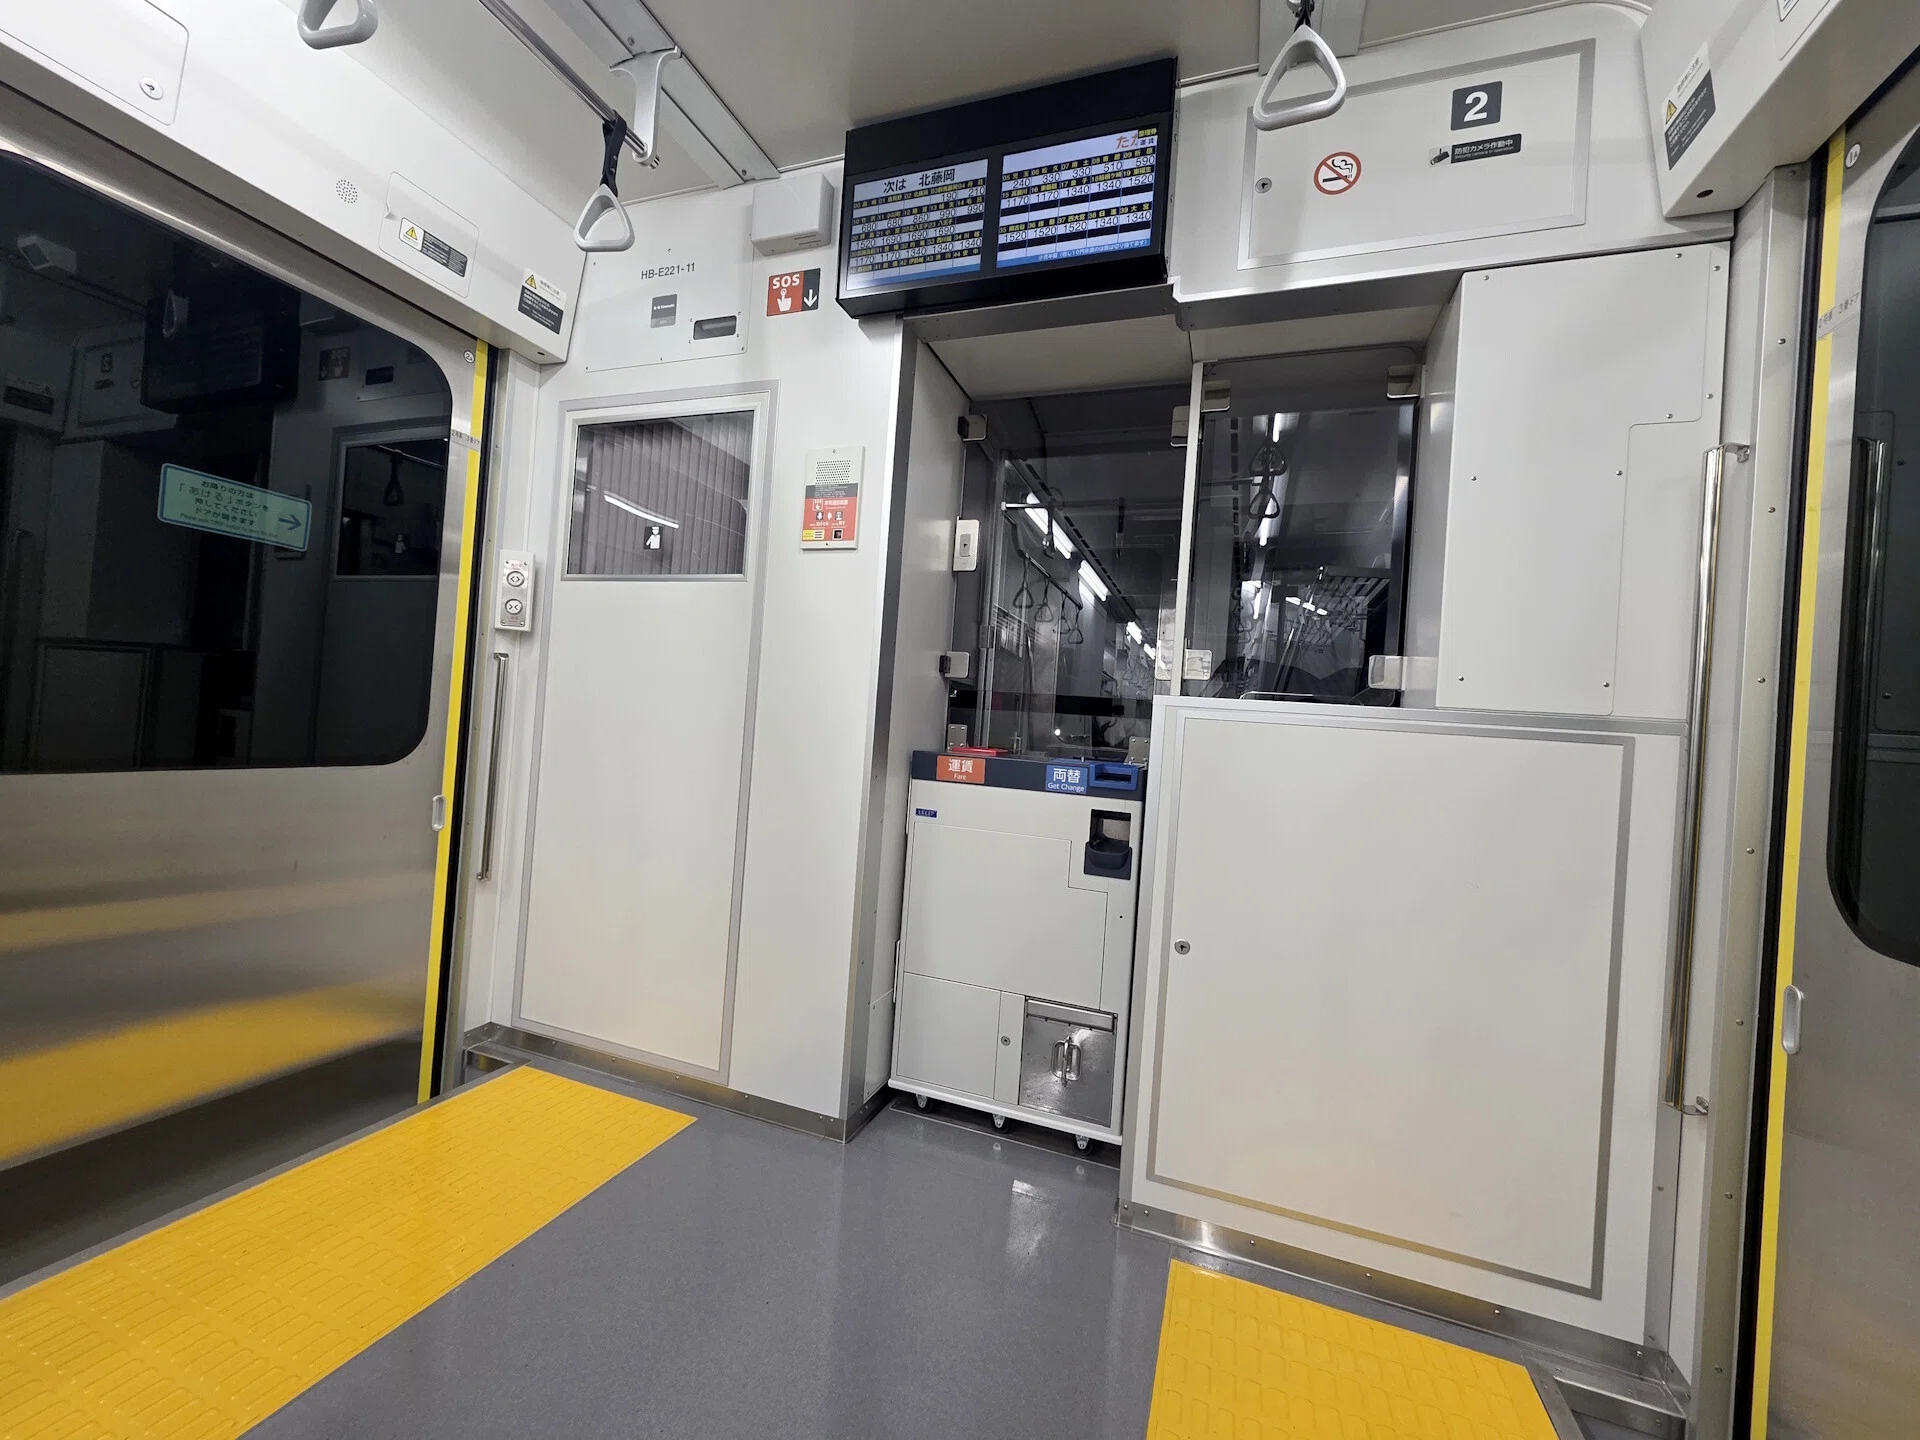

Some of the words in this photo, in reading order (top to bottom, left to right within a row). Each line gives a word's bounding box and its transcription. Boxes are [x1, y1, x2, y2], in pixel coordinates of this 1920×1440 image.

[1464, 91, 1488, 122] 2
[1454, 139, 1513, 155] 防犯カメラ作動中
[1014, 178, 1030, 188] 240
[1043, 173, 1060, 183] 330
[1073, 167, 1090, 178] 330
[1104, 161, 1122, 172] 510
[1136, 155, 1155, 166] 590
[883, 178, 907, 194] 次は
[919, 169, 955, 187] 北藤岡
[1007, 196, 1029, 206] 1170
[1036, 190, 1059, 201] 1170
[1066, 185, 1089, 196] 1340
[1097, 180, 1121, 191] 1340
[1129, 174, 1153, 186] 1520
[941, 192, 957, 201] 190
[969, 187, 985, 197] 210
[862, 223, 876, 232] 680
[887, 218, 902, 228] 680
[913, 214, 929, 223] 860
[940, 209, 956, 218] 990
[967, 204, 984, 214] 990
[1005, 231, 1027, 241] 1520
[1034, 226, 1057, 237] 1520
[1064, 221, 1087, 232] 1520
[1095, 217, 1118, 228] 1340
[1126, 211, 1151, 223] 1340
[856, 239, 875, 249] 1520
[882, 235, 901, 245] 1690
[907, 230, 927, 241] 1690
[934, 226, 955, 236] 1690
[855, 256, 874, 265] 1170
[880, 252, 900, 261] 1170
[906, 247, 926, 257] 1340
[933, 243, 953, 253] 1340
[960, 239, 981, 249] 1340
[641, 262, 695, 280] HB-E221-11
[772, 274, 800, 290] SOS
[202, 480, 254, 498] お降りの方は
[194, 498, 257, 517] 押してください
[195, 508, 256, 526] ドアが開きます
[949, 758, 973, 773] 運賃
[1054, 768, 1080, 784] 両替
[1048, 782, 1060, 790] Get
[1061, 784, 1084, 792] Change
